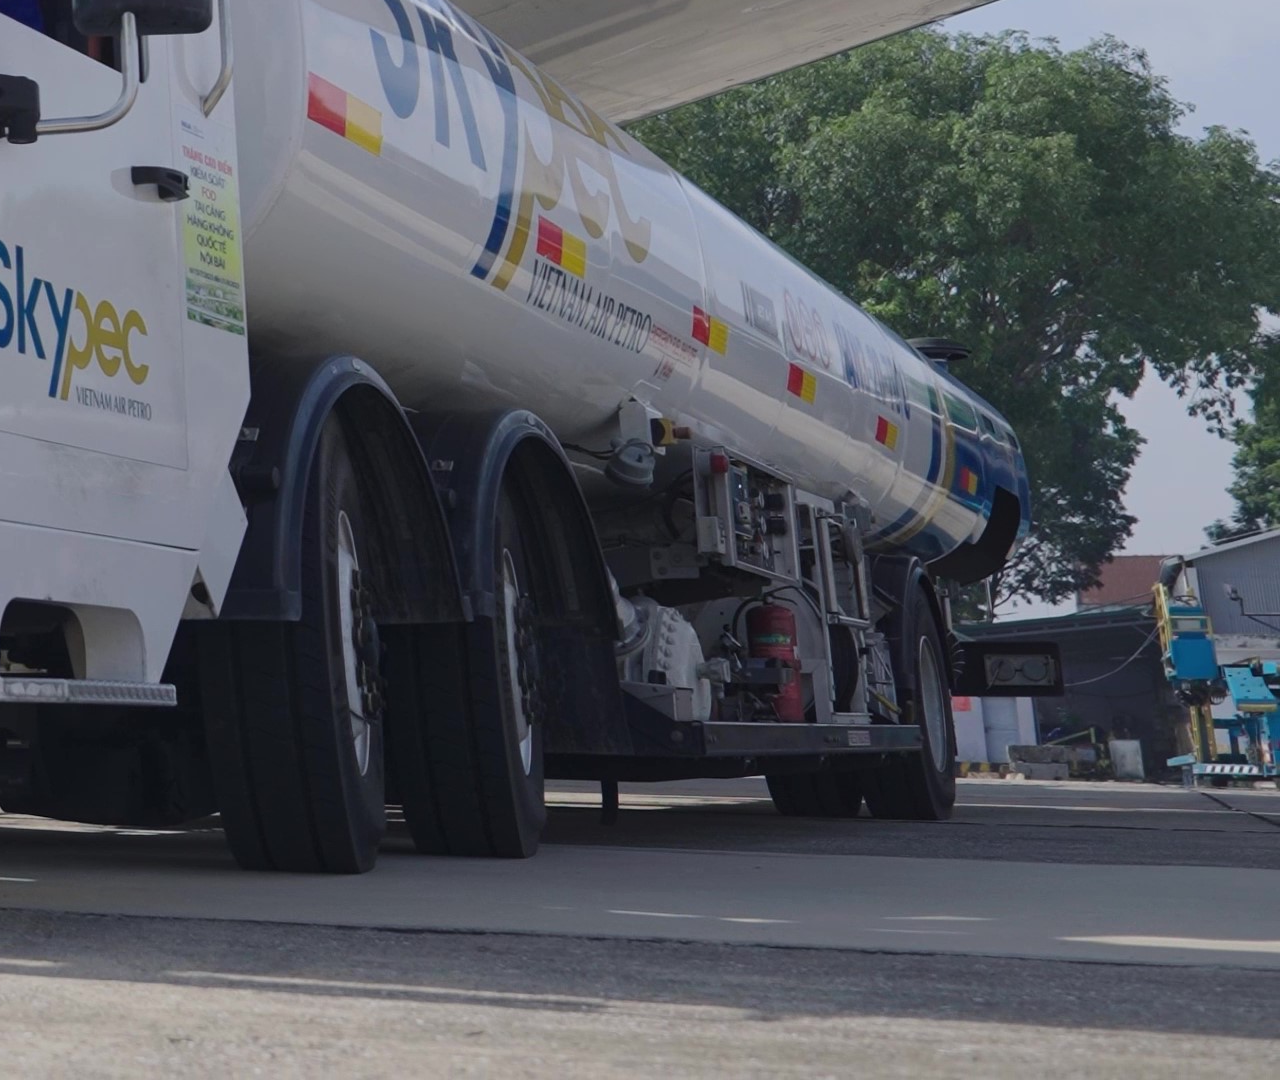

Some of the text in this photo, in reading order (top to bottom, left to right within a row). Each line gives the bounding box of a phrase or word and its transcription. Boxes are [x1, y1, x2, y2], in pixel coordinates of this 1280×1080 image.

[202, 186, 216, 201] FOD
[526, 259, 593, 327] VIETNAM
[584, 291, 614, 339] AIR
[608, 302, 652, 354] PETRO
[76, 385, 152, 421] VIETNAM AIR PETRO
